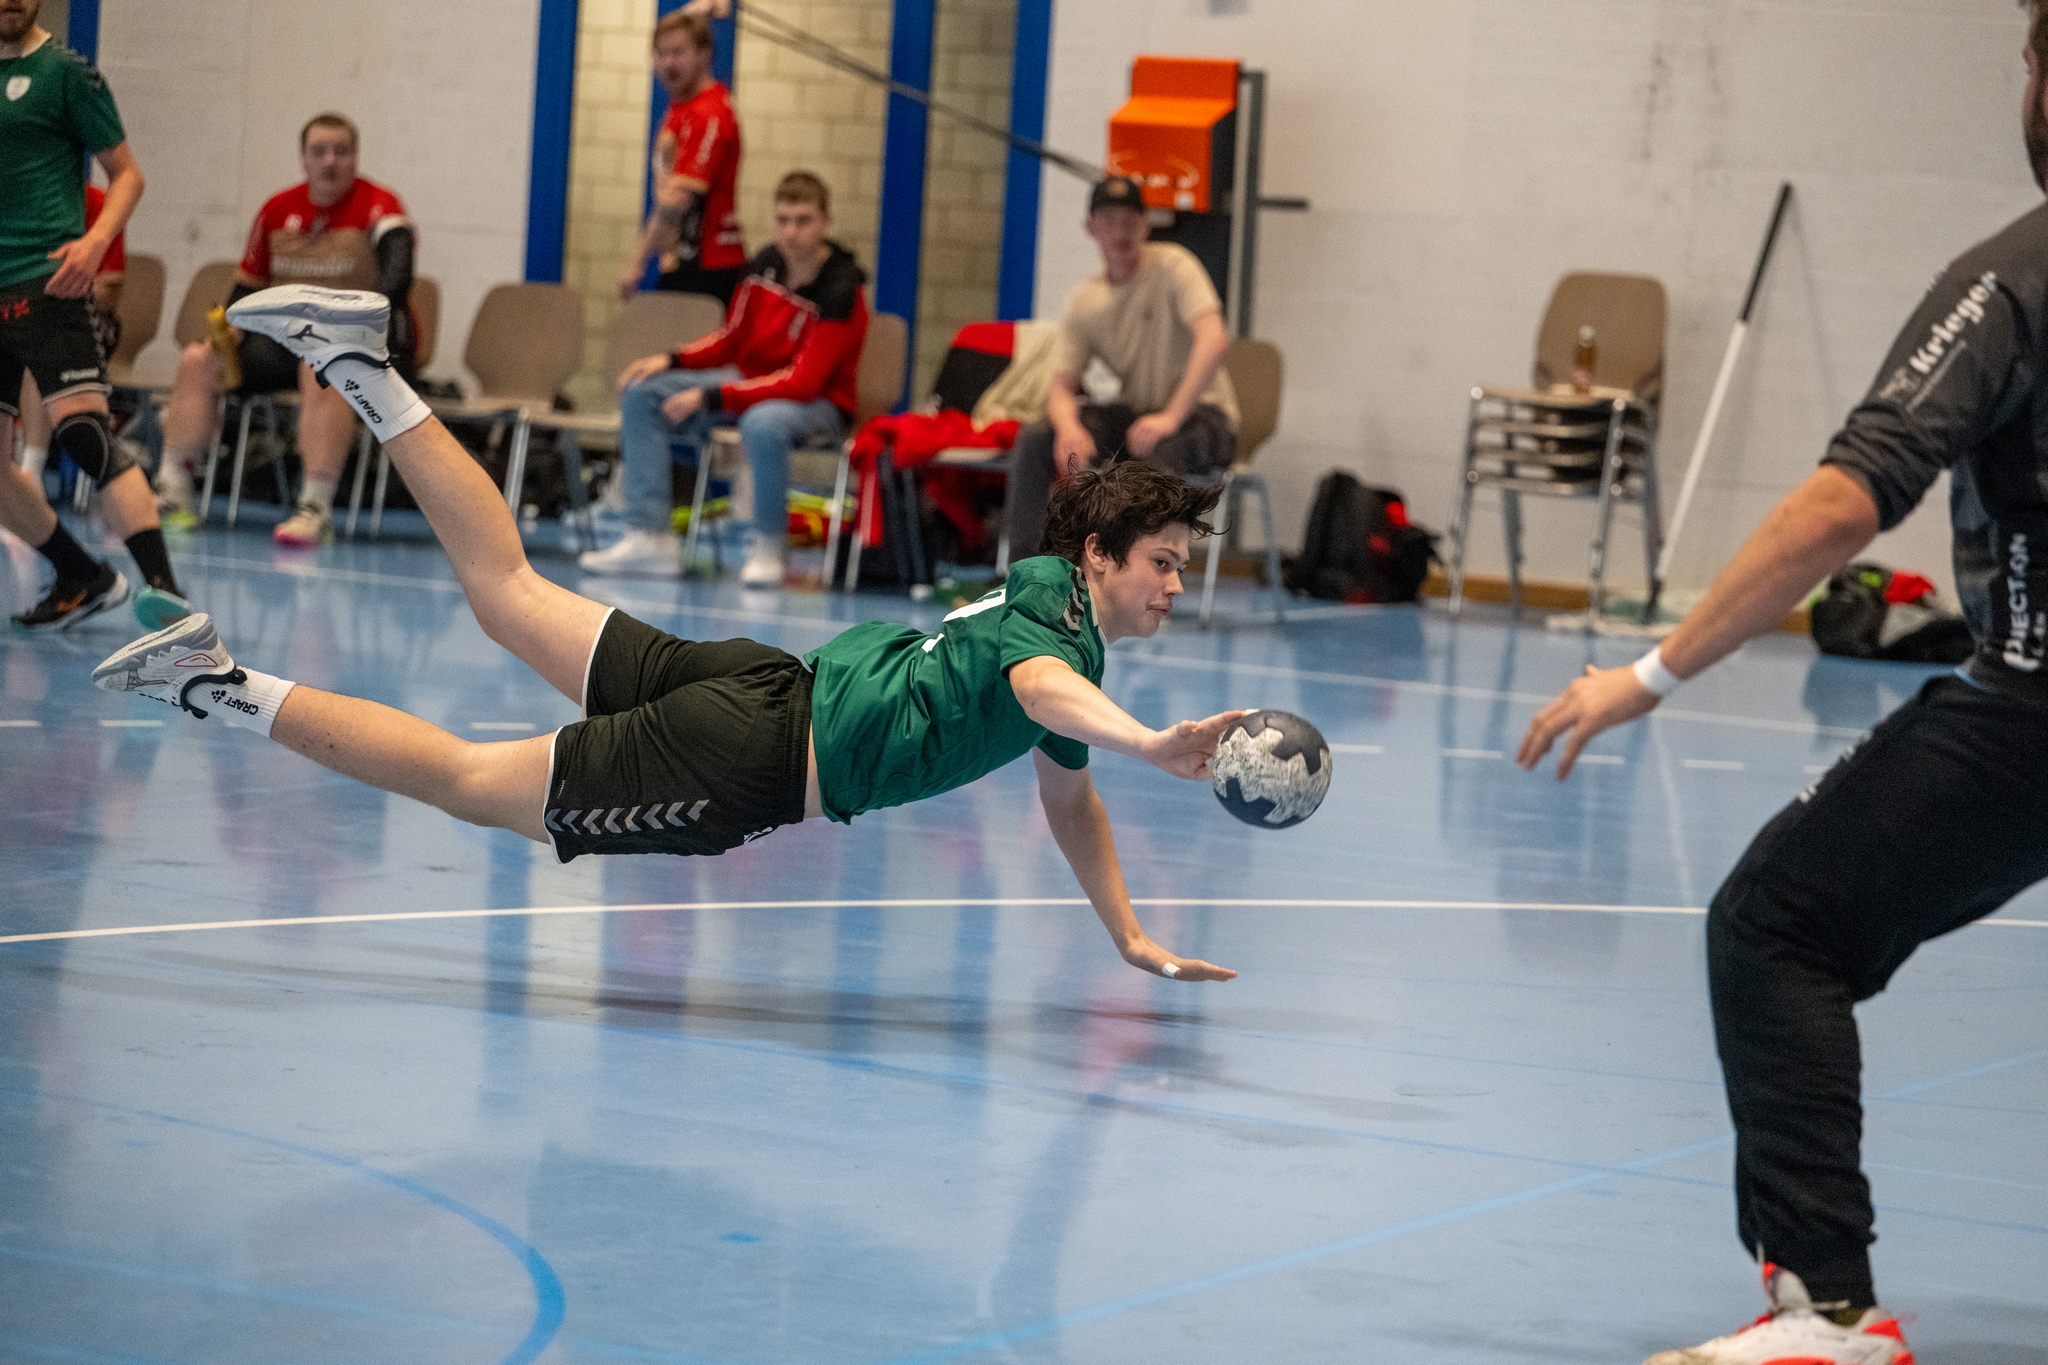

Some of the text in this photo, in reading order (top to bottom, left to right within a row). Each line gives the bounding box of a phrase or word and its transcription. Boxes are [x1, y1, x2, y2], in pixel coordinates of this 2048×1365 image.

[1908, 270, 1998, 375] Krieger
[352, 393, 383, 424] CRAFT
[224, 696, 259, 716] CRAFT
